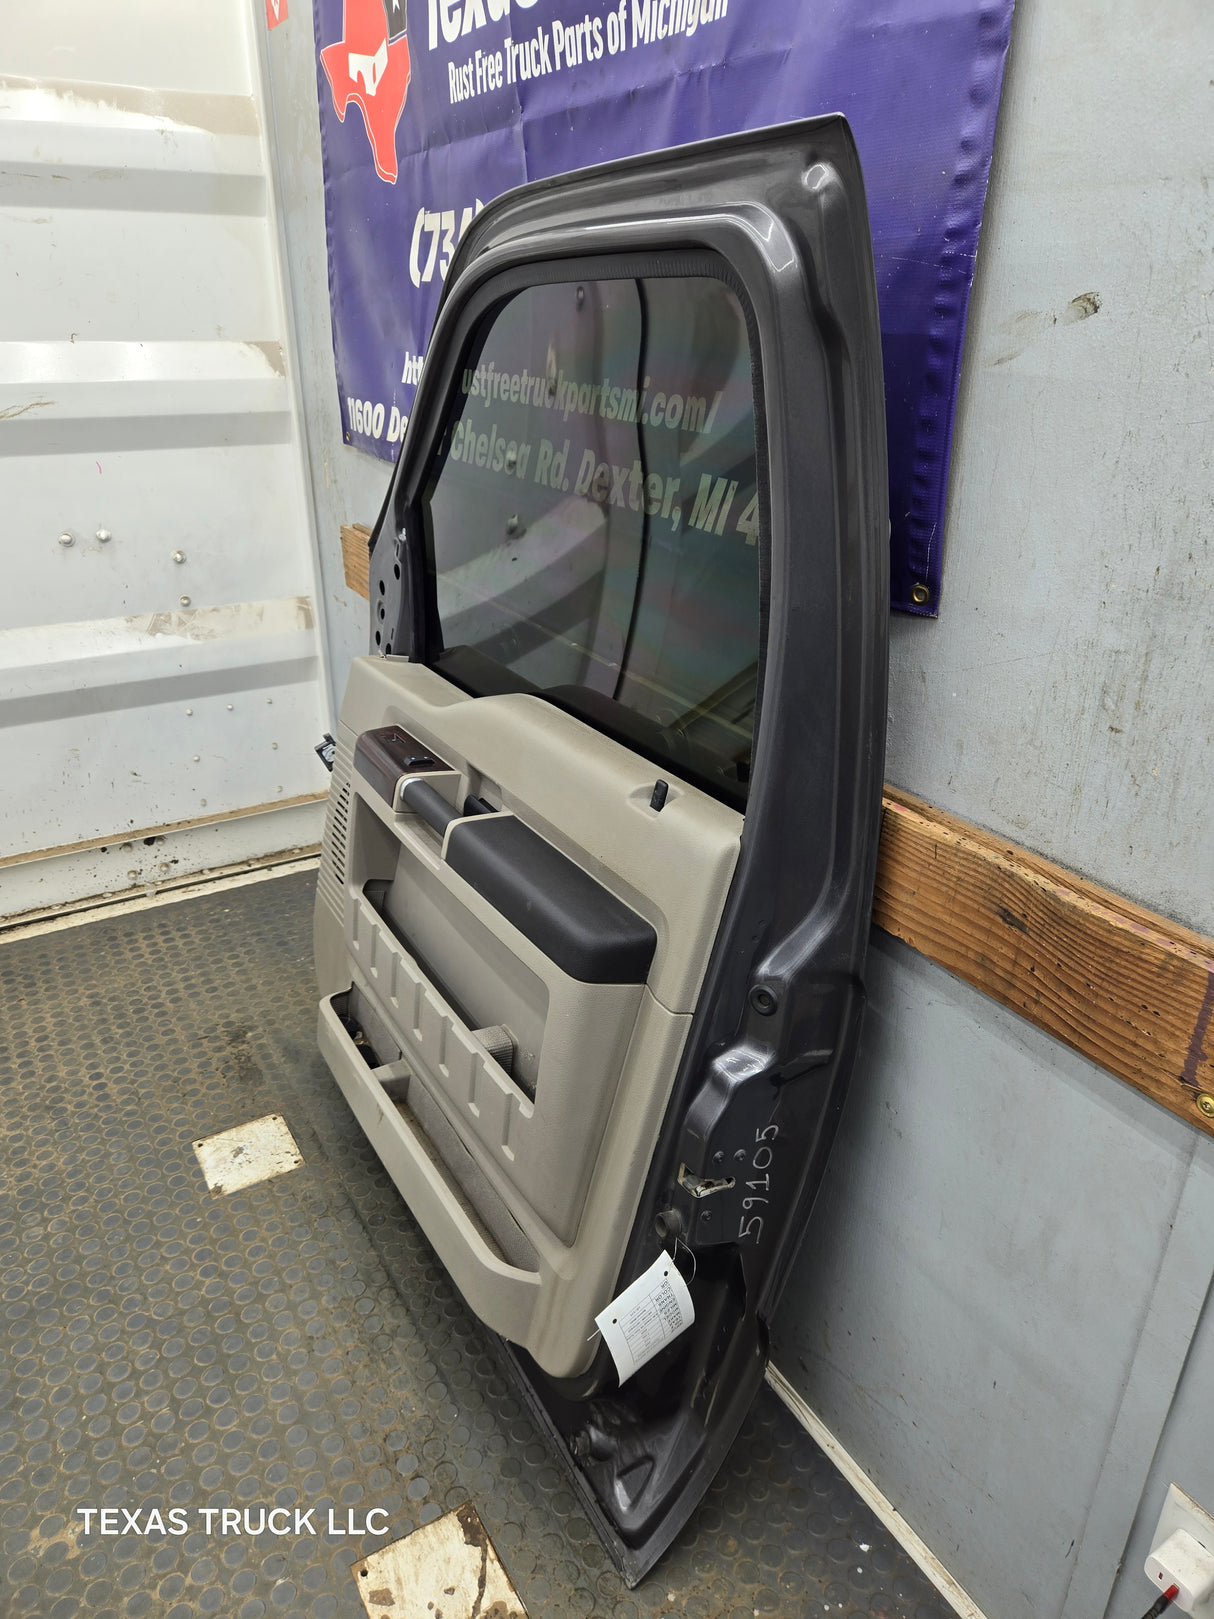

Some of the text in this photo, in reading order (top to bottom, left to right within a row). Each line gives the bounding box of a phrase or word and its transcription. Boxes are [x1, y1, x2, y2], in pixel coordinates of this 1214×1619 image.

[448, 0, 729, 104] Rust Free Truck Parts of Michigan
[347, 396, 385, 440] 11600
[450, 419, 529, 480] Chelsea
[534, 437, 571, 492] Rd.
[573, 448, 683, 532] Dexter,
[687, 472, 739, 536] MI
[735, 490, 760, 547] 4
[738, 1124, 779, 1244] 59105
[655, 1287, 671, 1302] COLOR
